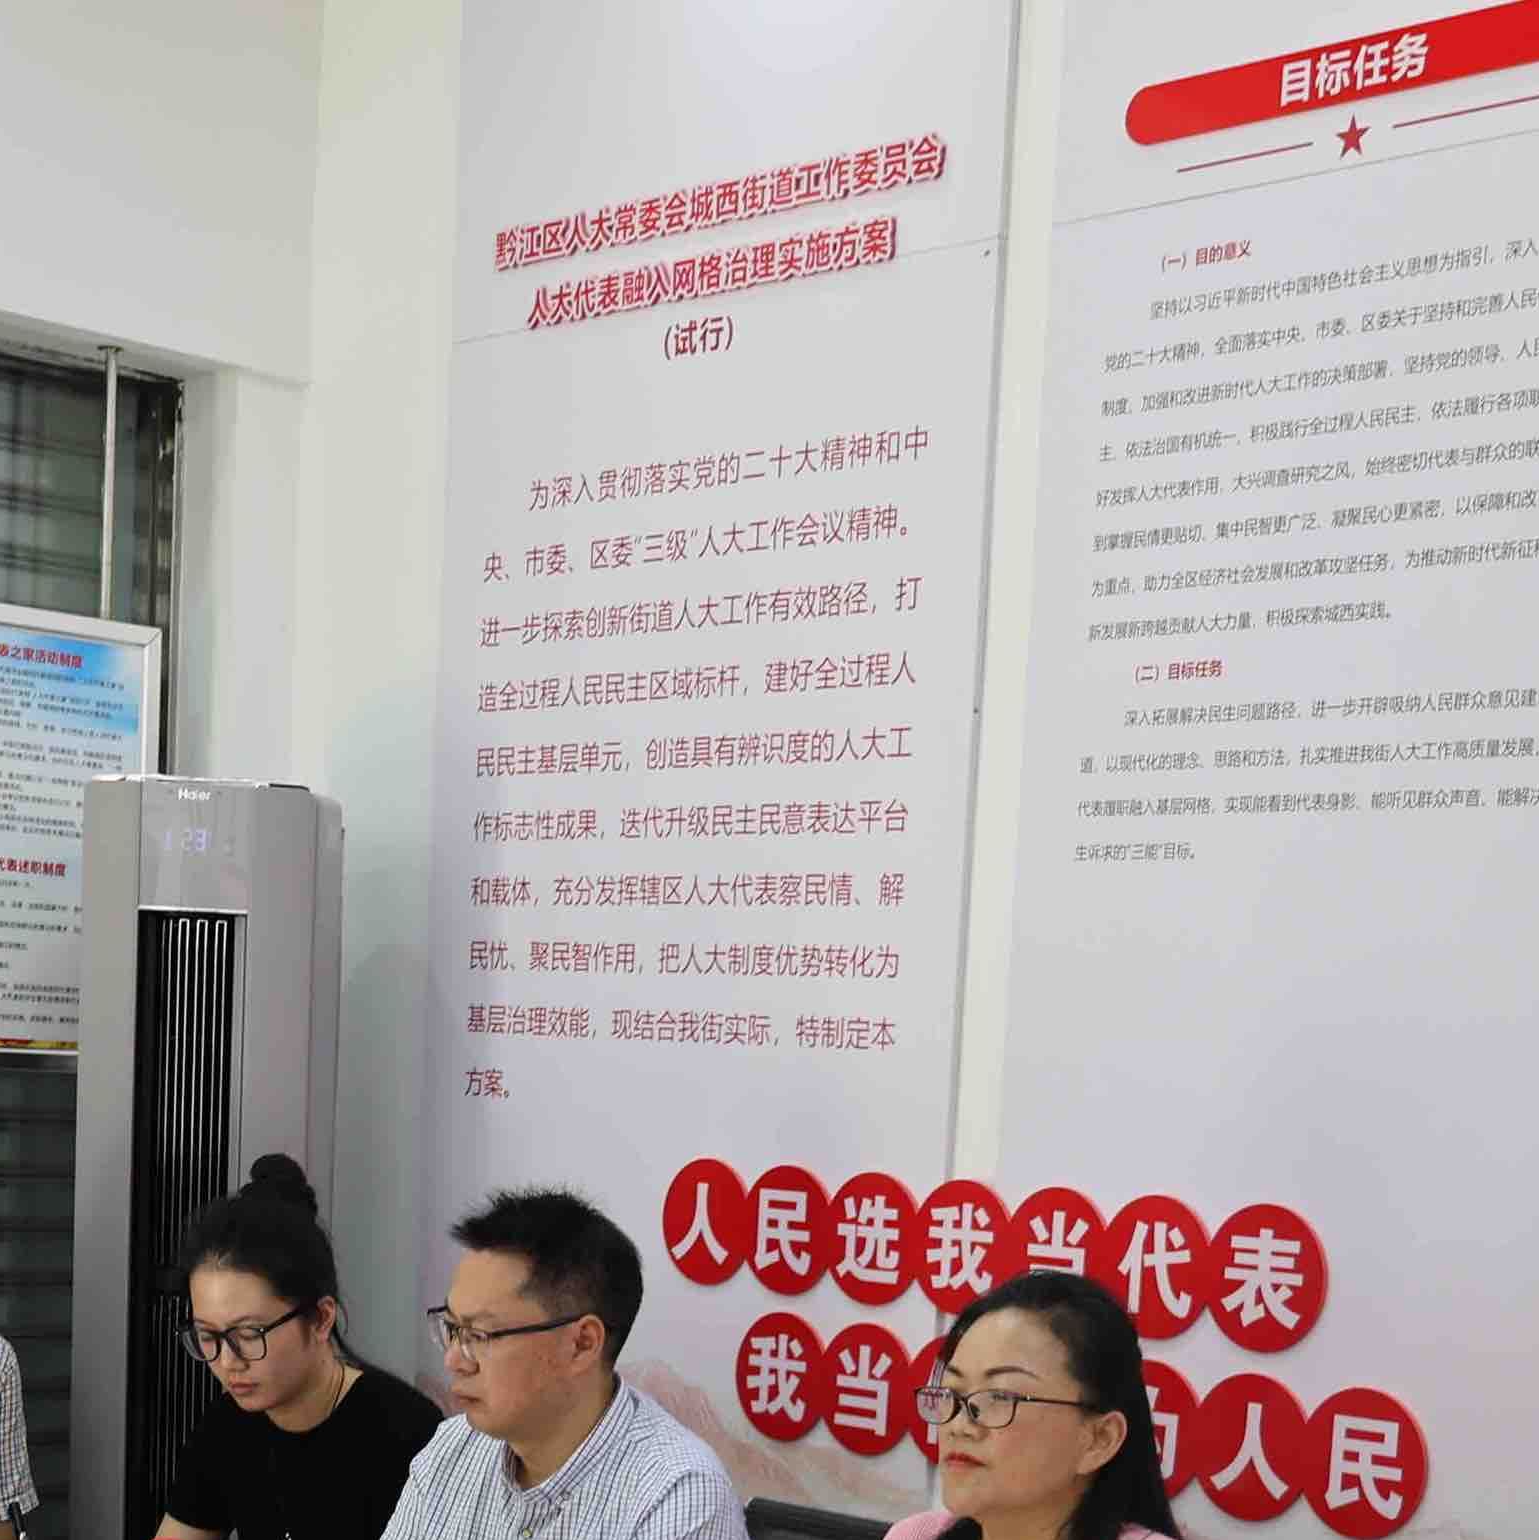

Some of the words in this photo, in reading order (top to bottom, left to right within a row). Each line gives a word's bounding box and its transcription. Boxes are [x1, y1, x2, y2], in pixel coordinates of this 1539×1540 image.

[1279, 33, 1430, 108] 目标任务
[494, 133, 948, 271] 黔江区人大常委会城西街道工作委员会
[526, 217, 898, 329] 人大代表融入网格治理实施方案
[663, 315, 736, 361] （试行）
[528, 423, 931, 511] 为深入贯彻落实党的二十大精神和中
[479, 574, 923, 648] 进一步探索创新街道人大工作有效路径，打
[477, 649, 918, 713] 造全过程人民民主区域标杆，建好全过程人
[1135, 659, 1223, 682] （二）目标任务
[475, 723, 914, 778] 民民主基层单元，创造具有辨识度的人大工
[472, 797, 909, 843] 作标志性成果，迭代升级民主民意表达平台
[470, 870, 905, 907] 和载体，充分发挥辖区人大代表察民情、解
[469, 940, 900, 978] 民忧、聚民智作用，把人大制度优势转化为
[466, 1004, 897, 1051] 基层治理效能，现结合我街实际，特制定本
[464, 1068, 510, 1097] 方案。
[671, 1182, 1304, 1330] 人民选我当代表
